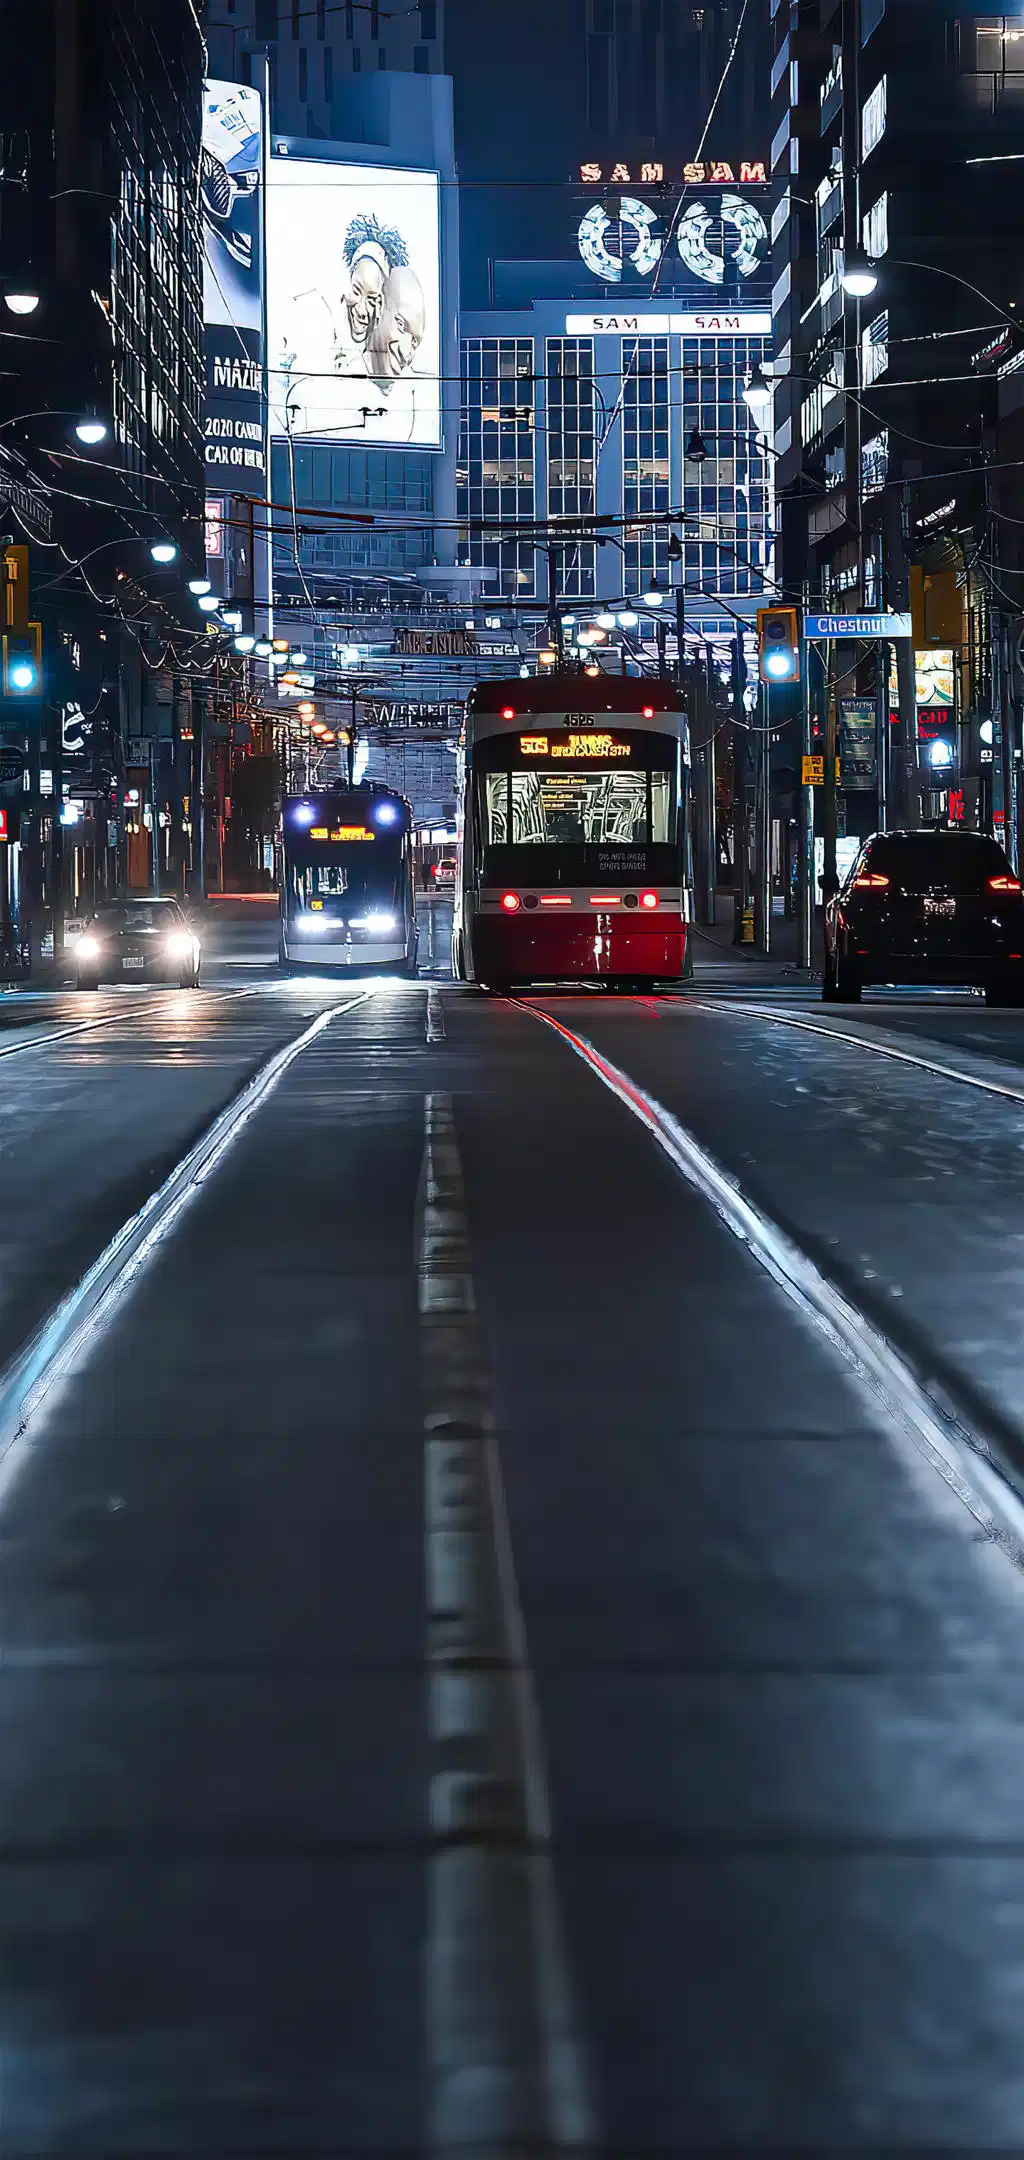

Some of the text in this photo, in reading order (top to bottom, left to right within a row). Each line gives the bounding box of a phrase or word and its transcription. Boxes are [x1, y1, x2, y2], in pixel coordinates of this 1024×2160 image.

[580, 161, 767, 183] SAM SAM
[593, 317, 639, 329] SAM
[695, 316, 740, 328] SAM
[204, 417, 233, 437] 2020
[204, 444, 229, 464] CAR
[817, 616, 886, 633] Chestnut
[520, 737, 548, 754] 505
